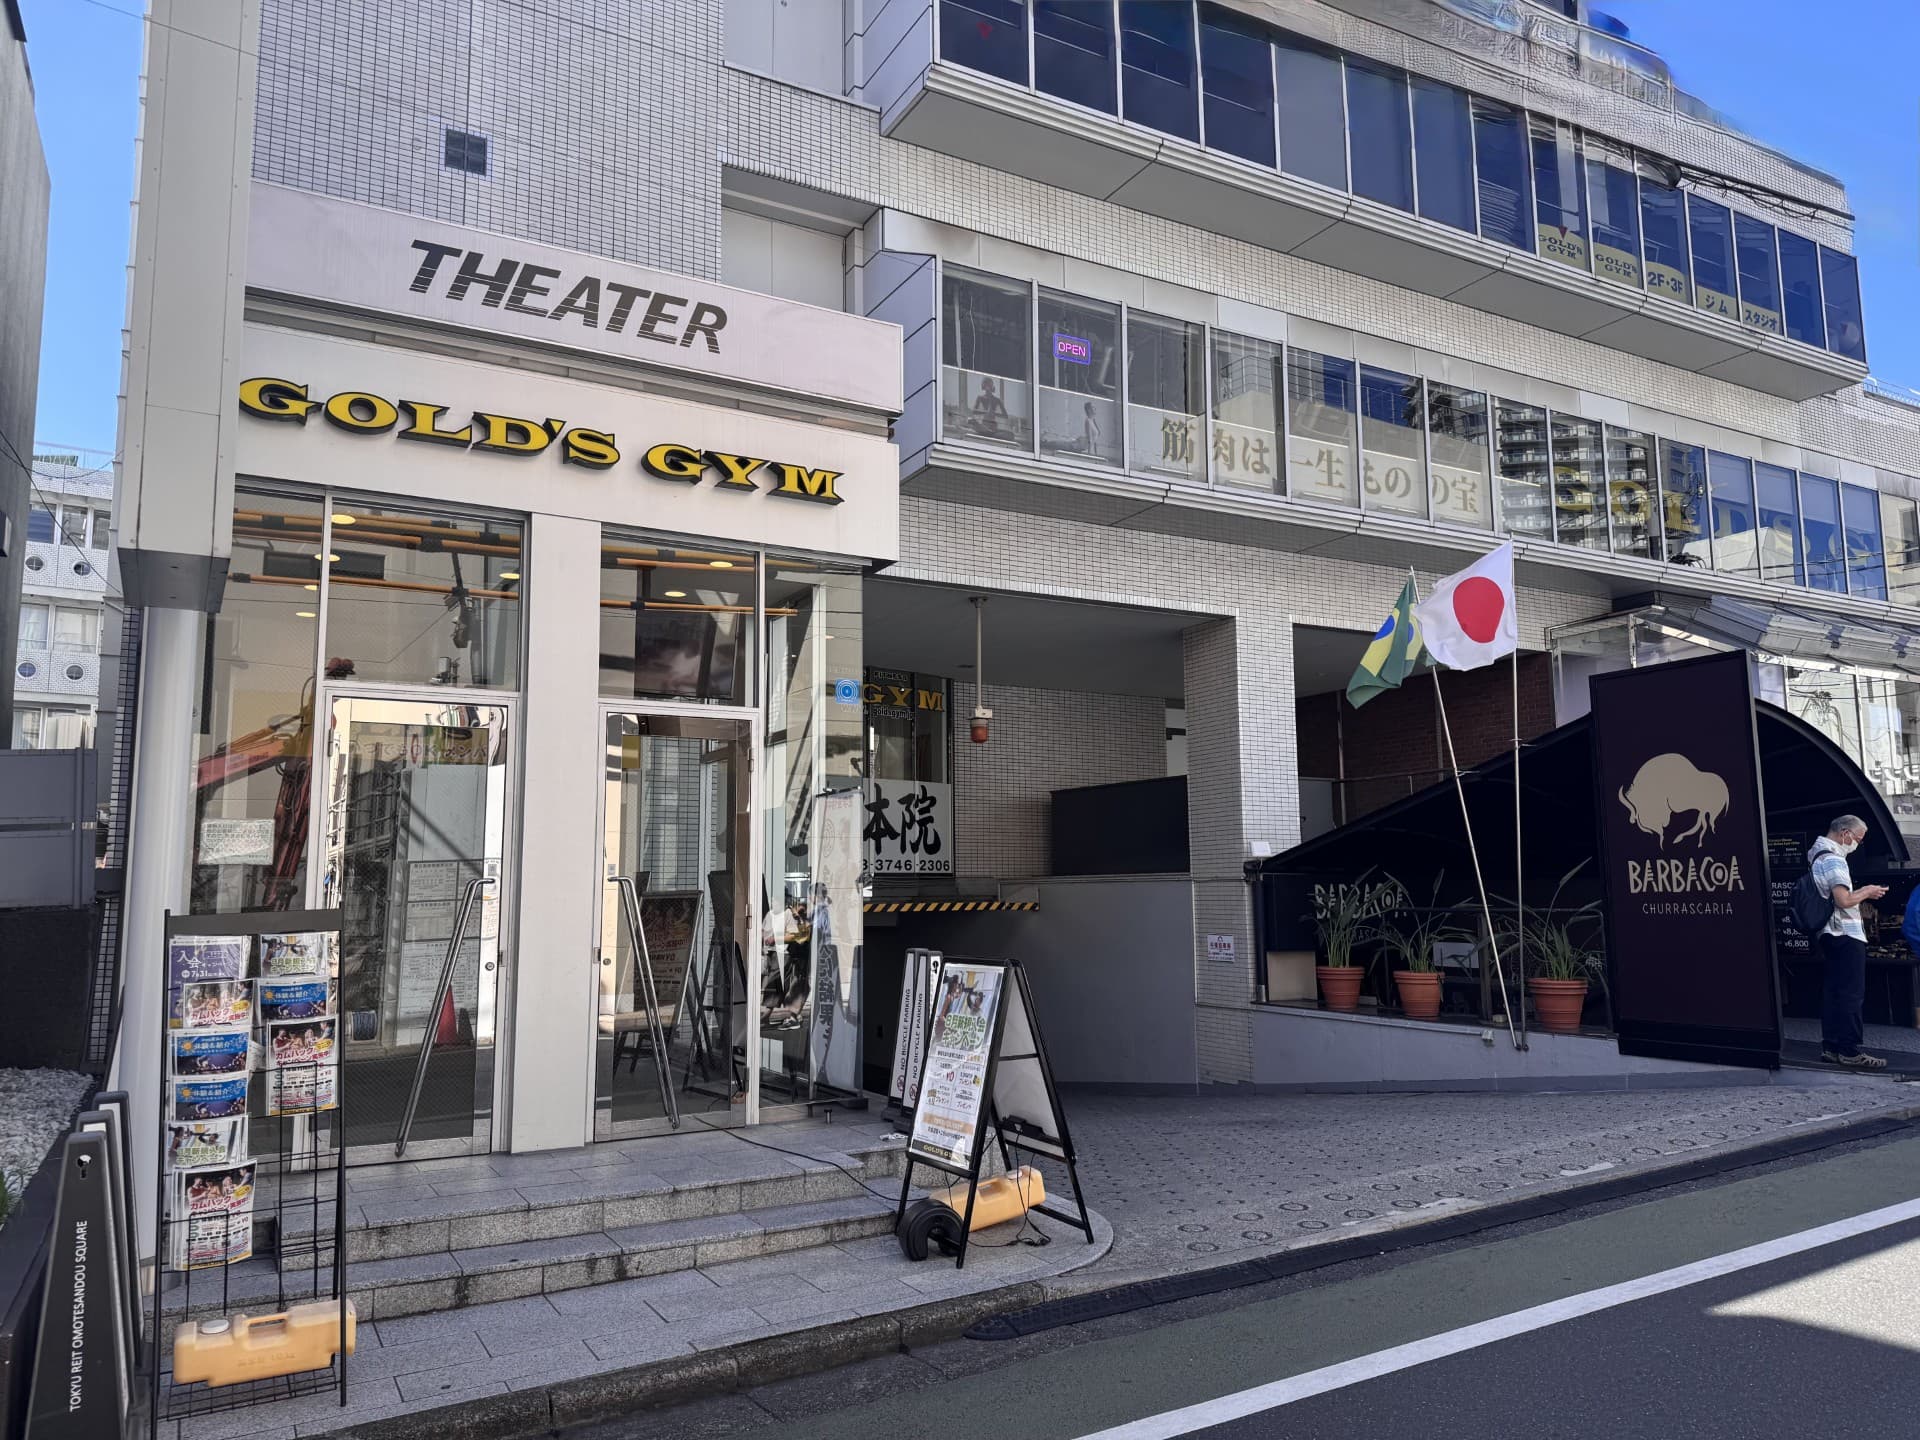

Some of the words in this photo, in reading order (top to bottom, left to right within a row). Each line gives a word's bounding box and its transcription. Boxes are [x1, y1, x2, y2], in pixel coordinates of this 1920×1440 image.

[1547, 244, 1577, 261] GYM
[1595, 253, 1638, 274] GOLD'S
[1604, 263, 1632, 279] GYM
[409, 240, 728, 354] THEATER
[1745, 308, 1779, 331] スタジオ
[1058, 341, 1087, 357] OPEN
[240, 377, 621, 471] GOLD'S
[641, 442, 845, 506] GYM
[862, 683, 945, 712] GYM
[1628, 855, 1745, 893] BARBACOA
[1642, 902, 1733, 915] CHURRASCARIA
[903, 988, 912, 1023] PARKING
[915, 993, 924, 1028] PARKING
[913, 1031, 921, 1062] BICYCLE
[76, 1220, 88, 1262] SQUARE
[72, 1264, 87, 1348] OMOTESANDOU
[72, 1350, 84, 1374] REIT
[69, 1377, 83, 1412] TOKYU
